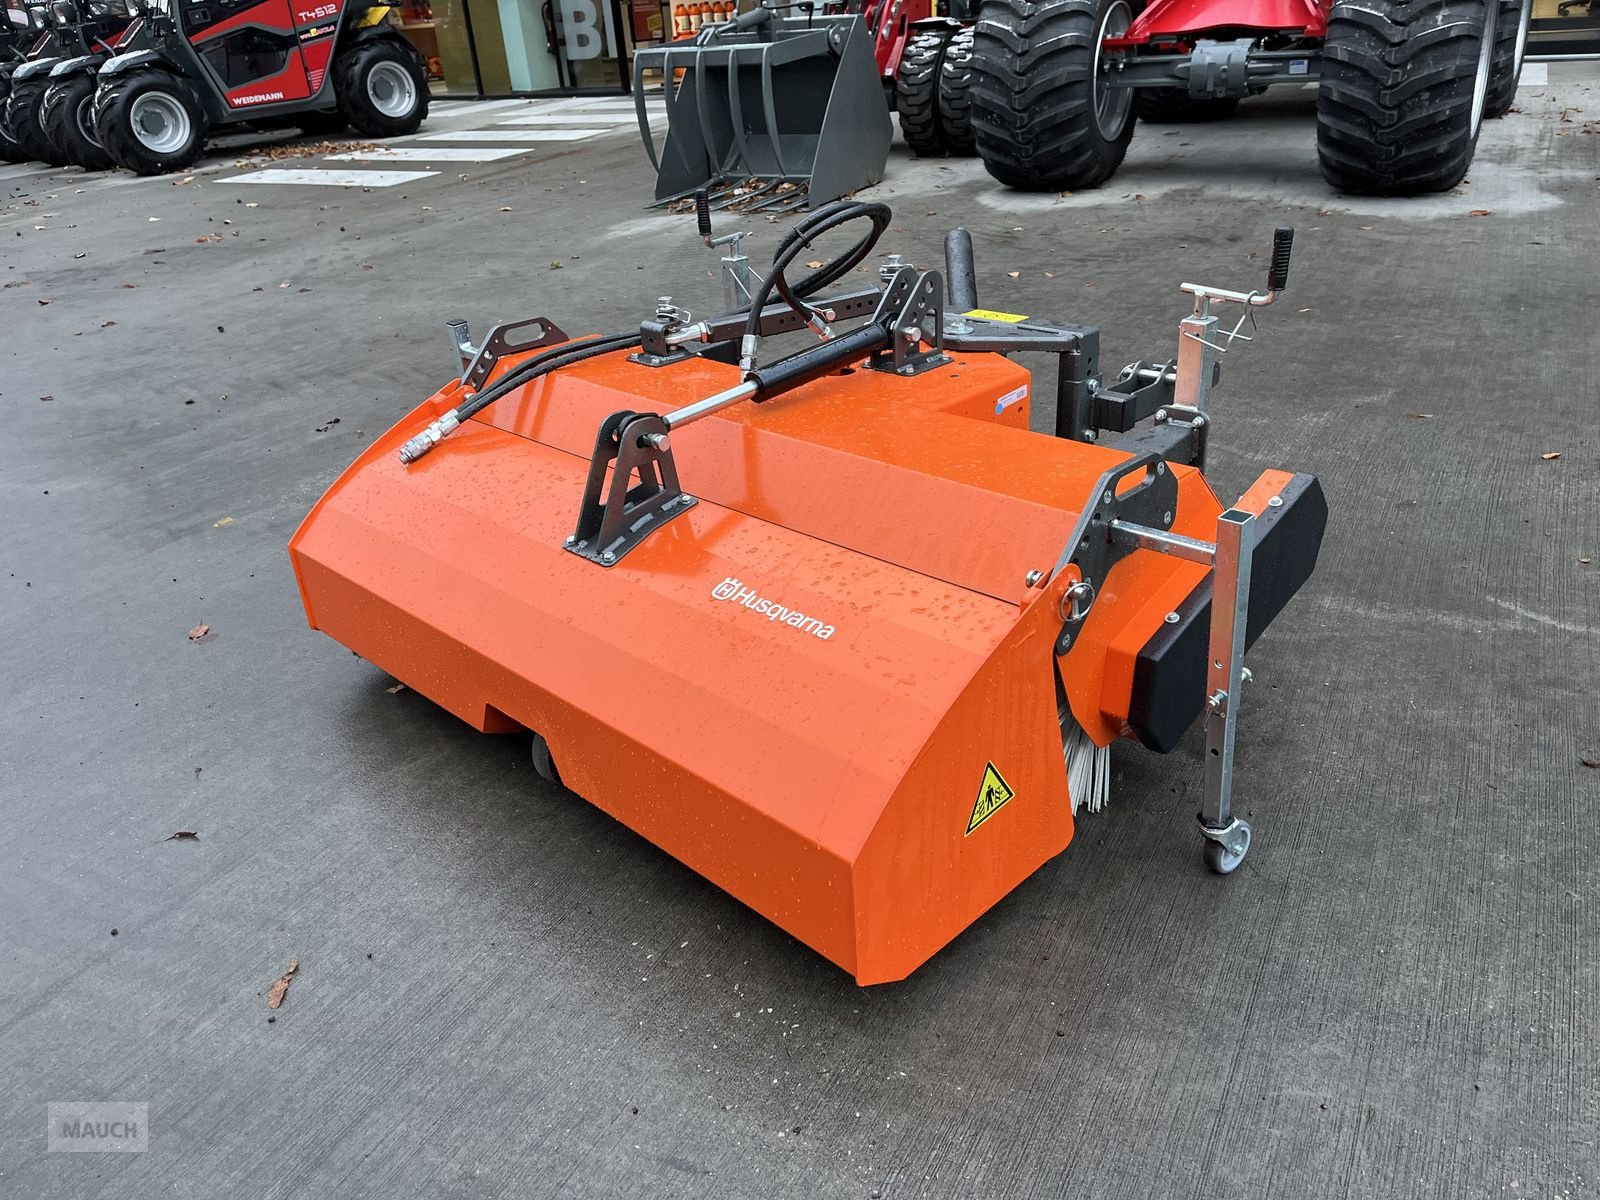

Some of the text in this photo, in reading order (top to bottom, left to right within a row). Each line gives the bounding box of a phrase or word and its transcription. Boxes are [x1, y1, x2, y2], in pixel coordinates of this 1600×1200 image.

[299, 4, 337, 21] T4512
[233, 92, 283, 105] WEIDEMANN
[731, 587, 836, 640] Husqvarna
